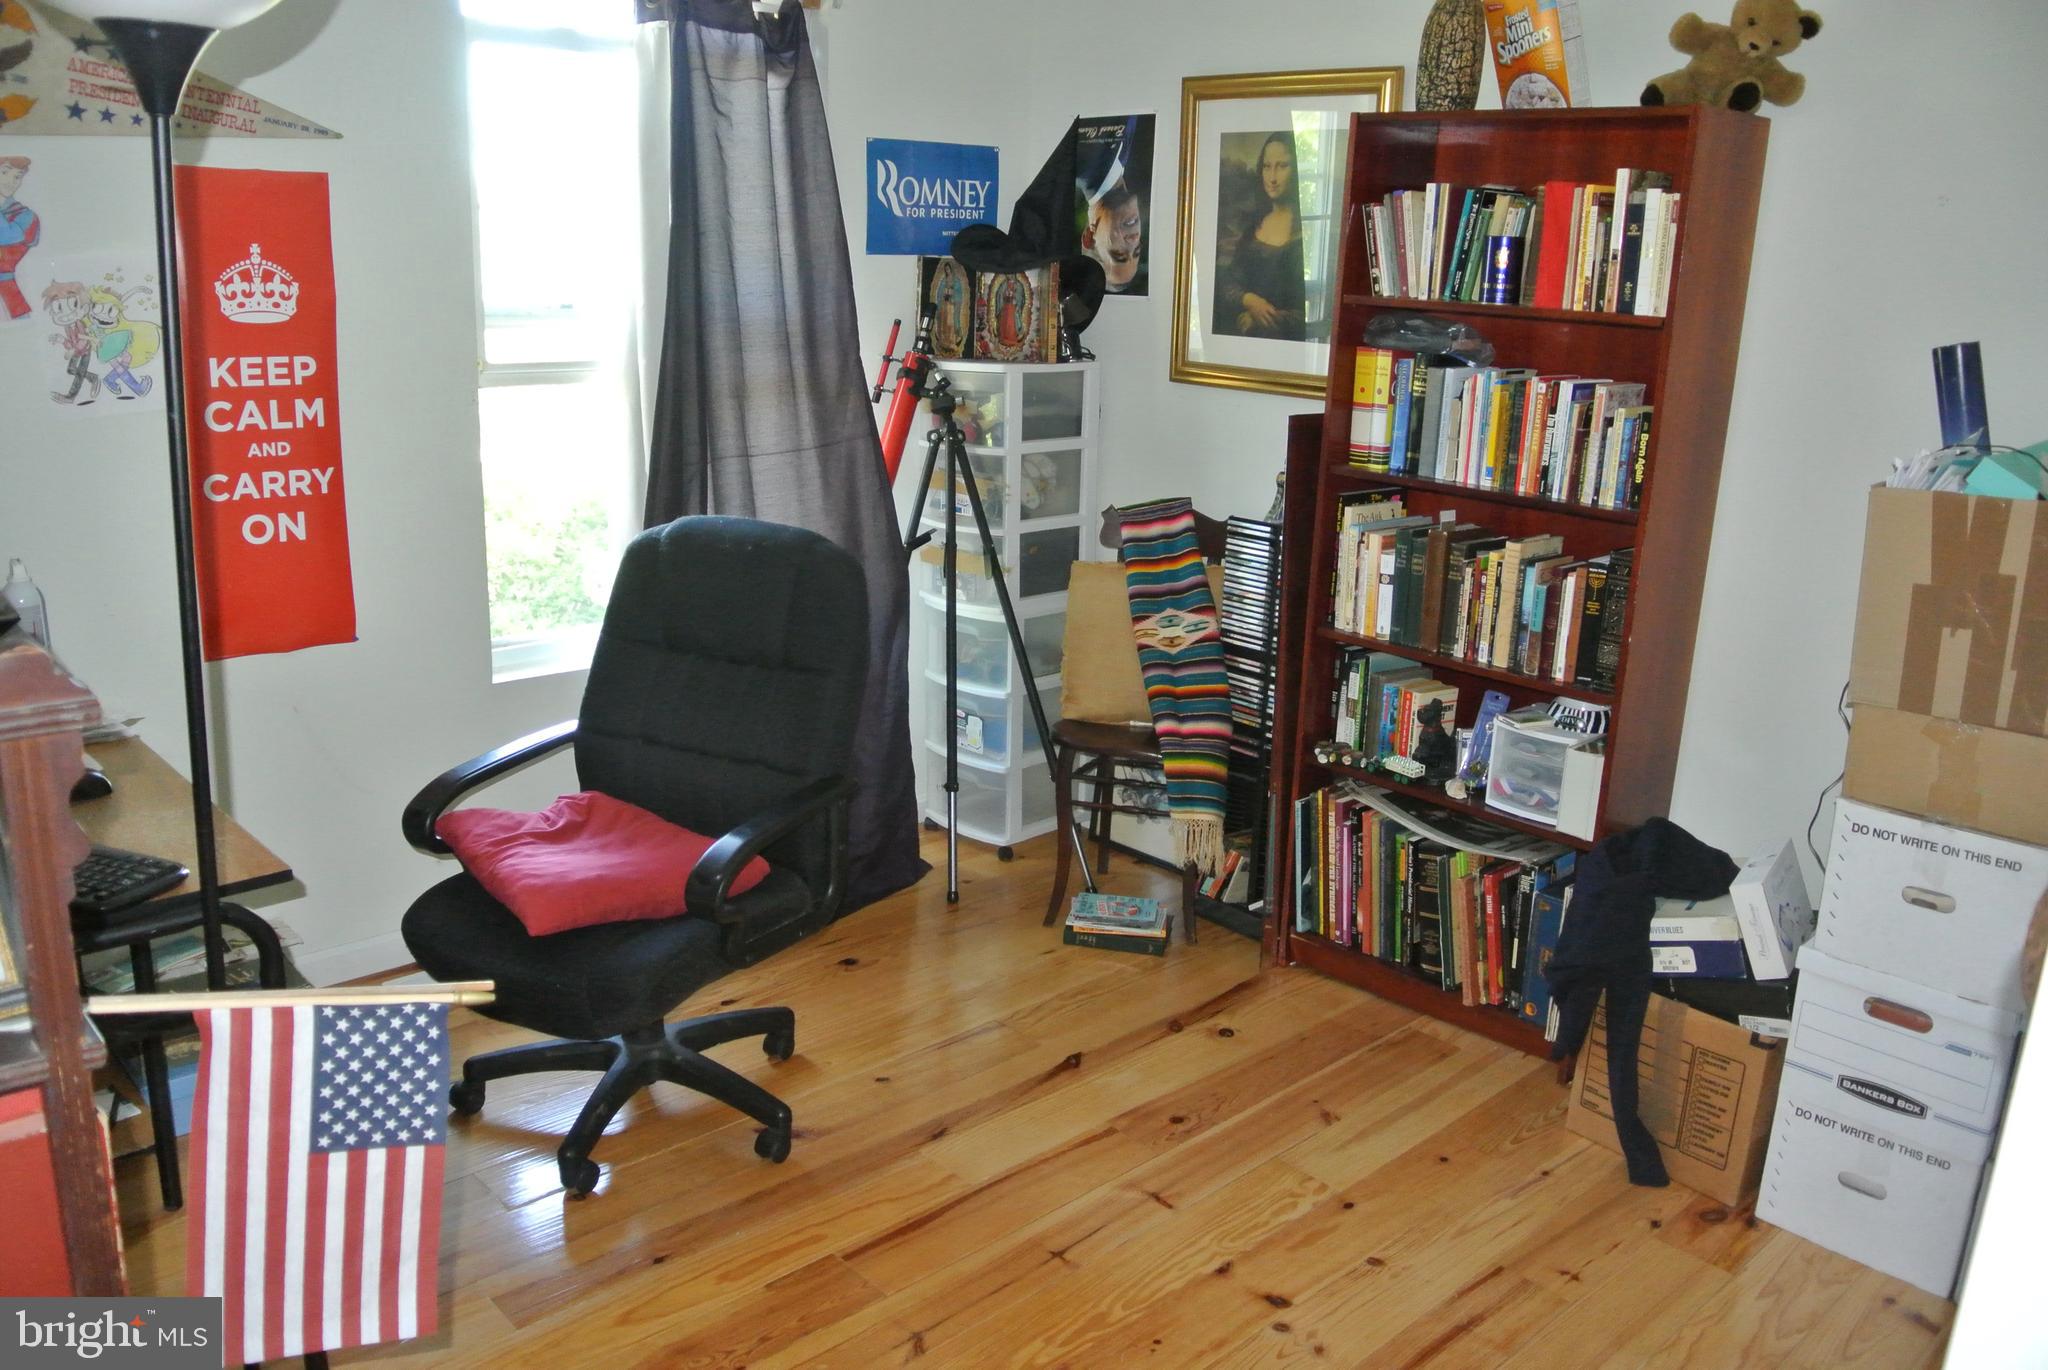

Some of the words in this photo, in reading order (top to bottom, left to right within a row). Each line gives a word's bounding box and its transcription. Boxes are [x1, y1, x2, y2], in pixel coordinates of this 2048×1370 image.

[1505, 6, 1529, 26] Frosted
[1506, 17, 1533, 43] Mini
[1497, 26, 1551, 64] Spooners
[69, 78, 140, 107] PRESIDEN
[181, 104, 257, 133] INAUGURAL
[185, 84, 261, 114] NTENNIAL
[877, 160, 991, 216] ROMNEY
[906, 207, 925, 218] FOR
[931, 208, 985, 219] PRESIDENT
[208, 356, 317, 388] KEEP
[204, 398, 325, 432] CALM
[248, 442, 291, 457] AND
[1639, 432, 1649, 457] Born
[203, 467, 334, 502] CARRY
[1633, 457, 1646, 484] Again
[242, 511, 307, 545] ON
[1852, 822, 1869, 835] DO
[1872, 827, 1898, 842] NOT
[1900, 834, 1938, 853] WRITE
[1941, 844, 1960, 858] ON
[1964, 849, 1992, 865] THIS
[1995, 857, 2022, 872] END
[1842, 1080, 1894, 1104] BANKERS
[1896, 1098, 1921, 1114] BOX
[1795, 1107, 1812, 1120] DO
[1814, 1113, 1837, 1129] NOT
[1840, 1120, 1874, 1143] WRITE
[1878, 1136, 1894, 1150] ON
[1897, 1143, 1923, 1161] THIS
[1926, 1155, 1951, 1170] END
